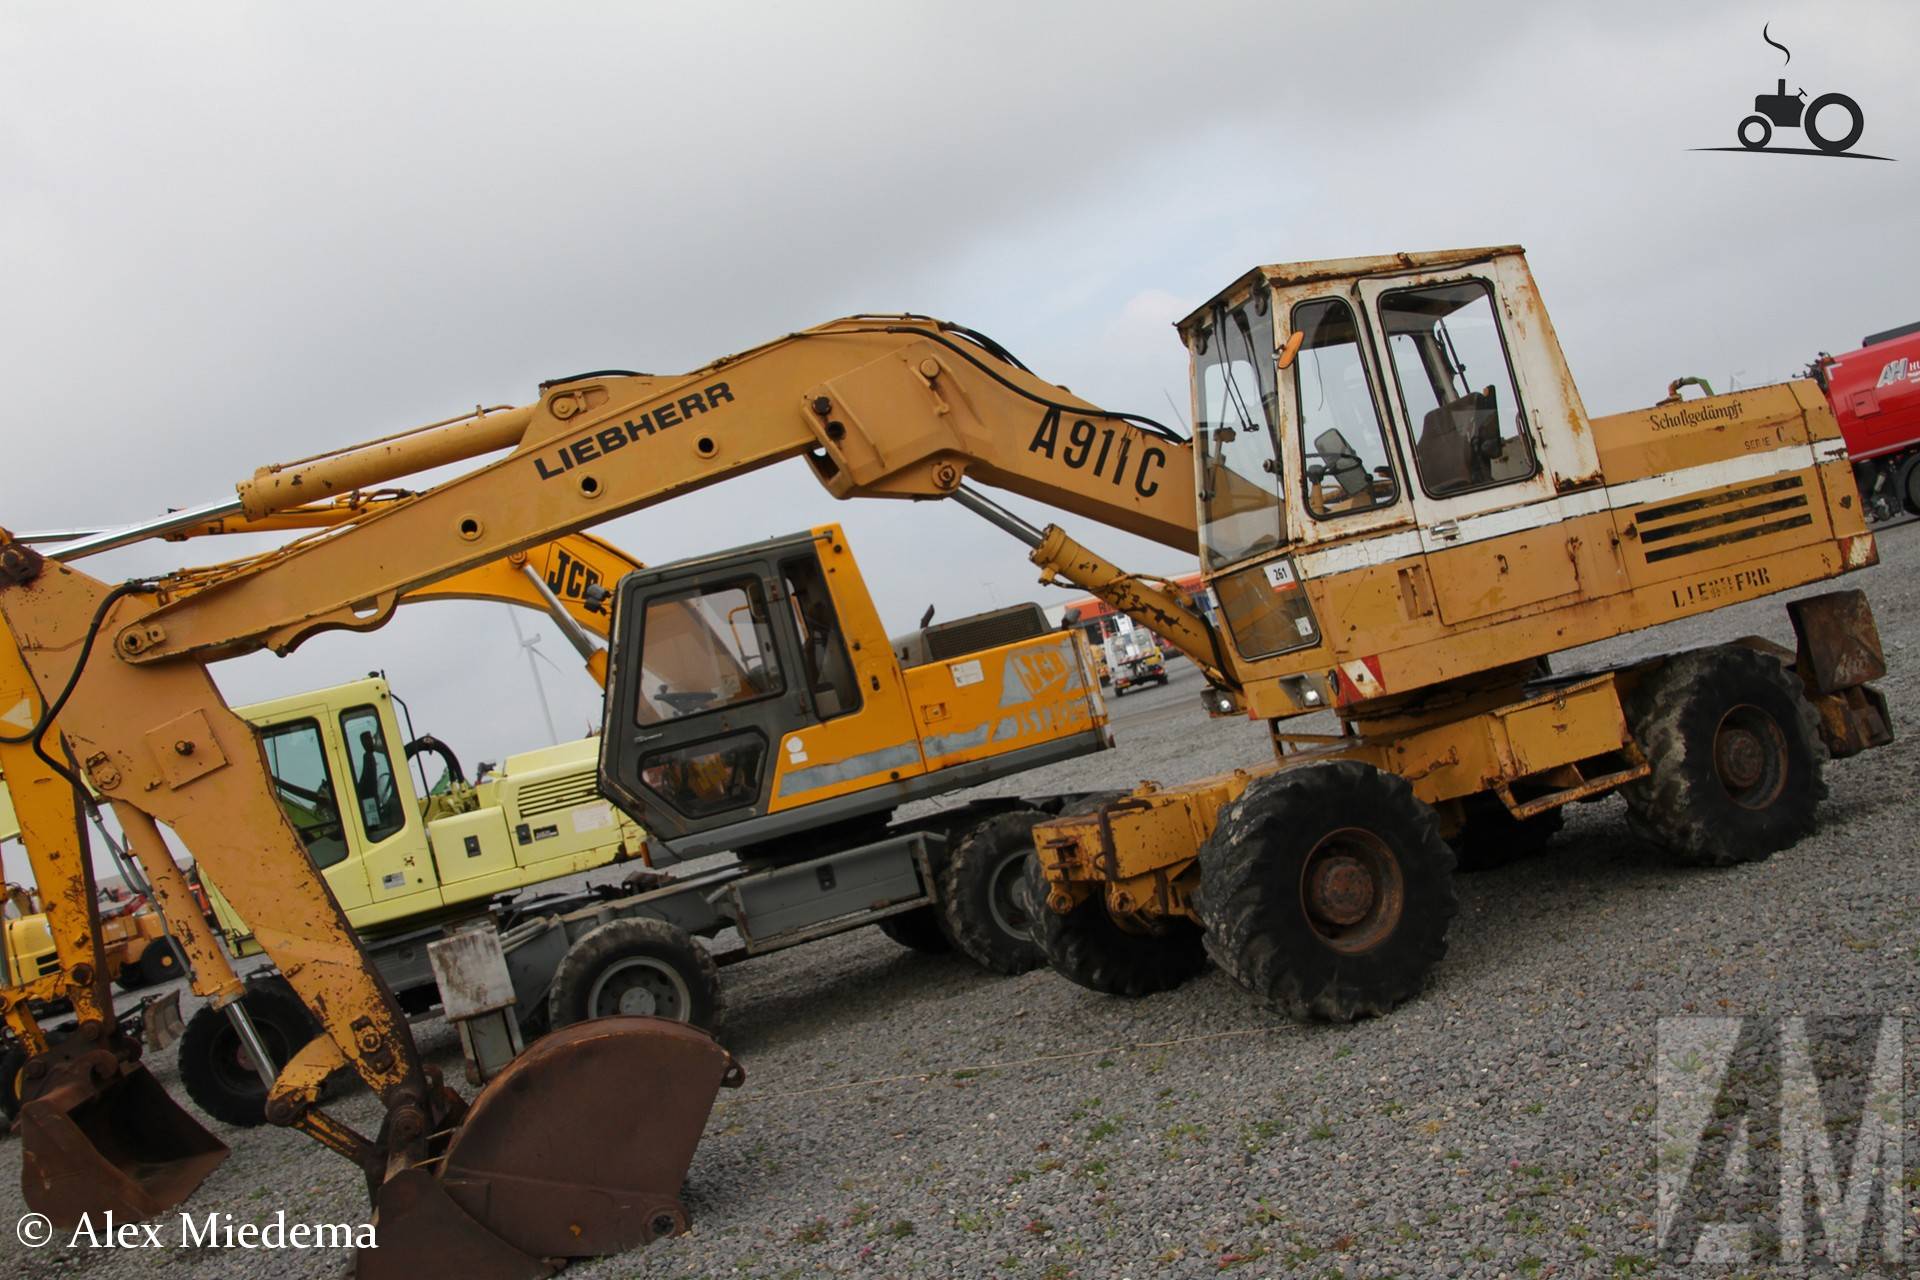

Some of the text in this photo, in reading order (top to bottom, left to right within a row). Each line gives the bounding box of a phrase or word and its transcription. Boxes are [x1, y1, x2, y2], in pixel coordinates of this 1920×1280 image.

[534, 381, 735, 480] LIEBHERR
[1650, 400, 1744, 431] Schallgedämpft
[1029, 405, 1166, 497] A911C
[1273, 567, 1288, 581] 261
